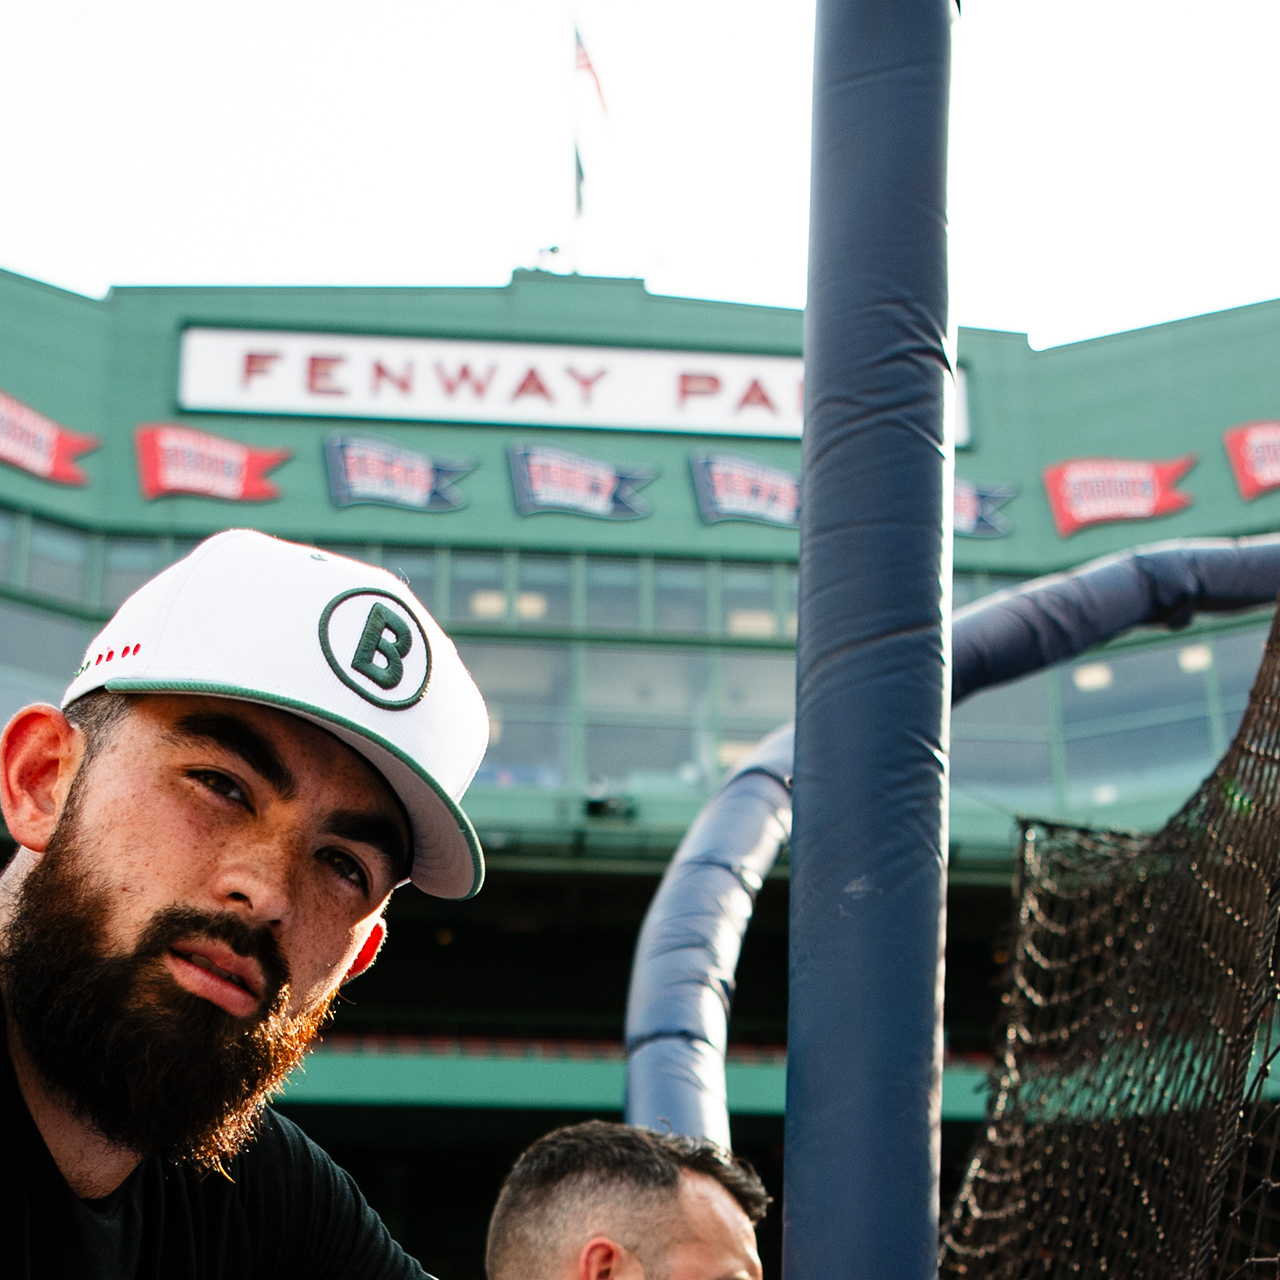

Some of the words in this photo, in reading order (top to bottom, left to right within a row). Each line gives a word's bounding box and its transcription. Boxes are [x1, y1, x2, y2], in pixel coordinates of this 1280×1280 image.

[241, 352, 609, 405] FENWAY
[676, 371, 804, 415] PA
[350, 601, 413, 691] B
